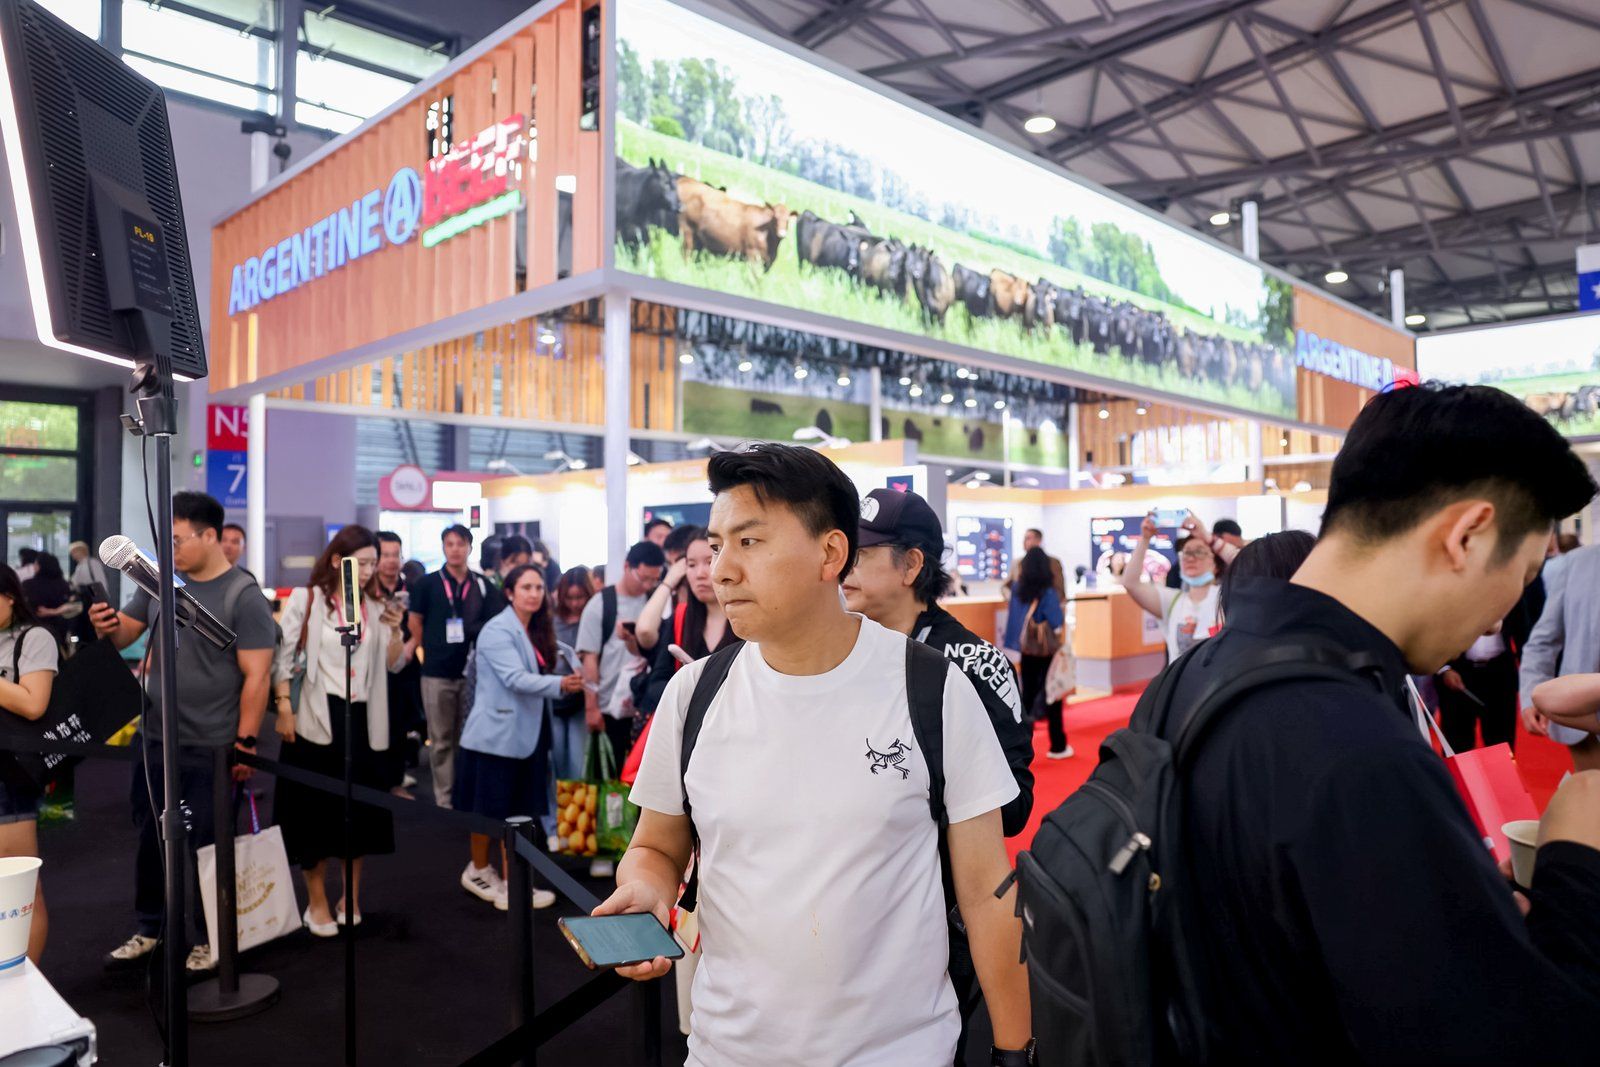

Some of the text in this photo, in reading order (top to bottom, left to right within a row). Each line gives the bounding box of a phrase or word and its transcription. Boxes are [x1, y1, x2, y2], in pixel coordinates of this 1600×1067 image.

[227, 188, 381, 317] ARGENTINE
[226, 464, 246, 494] 7
[962, 656, 1007, 691] FACE
